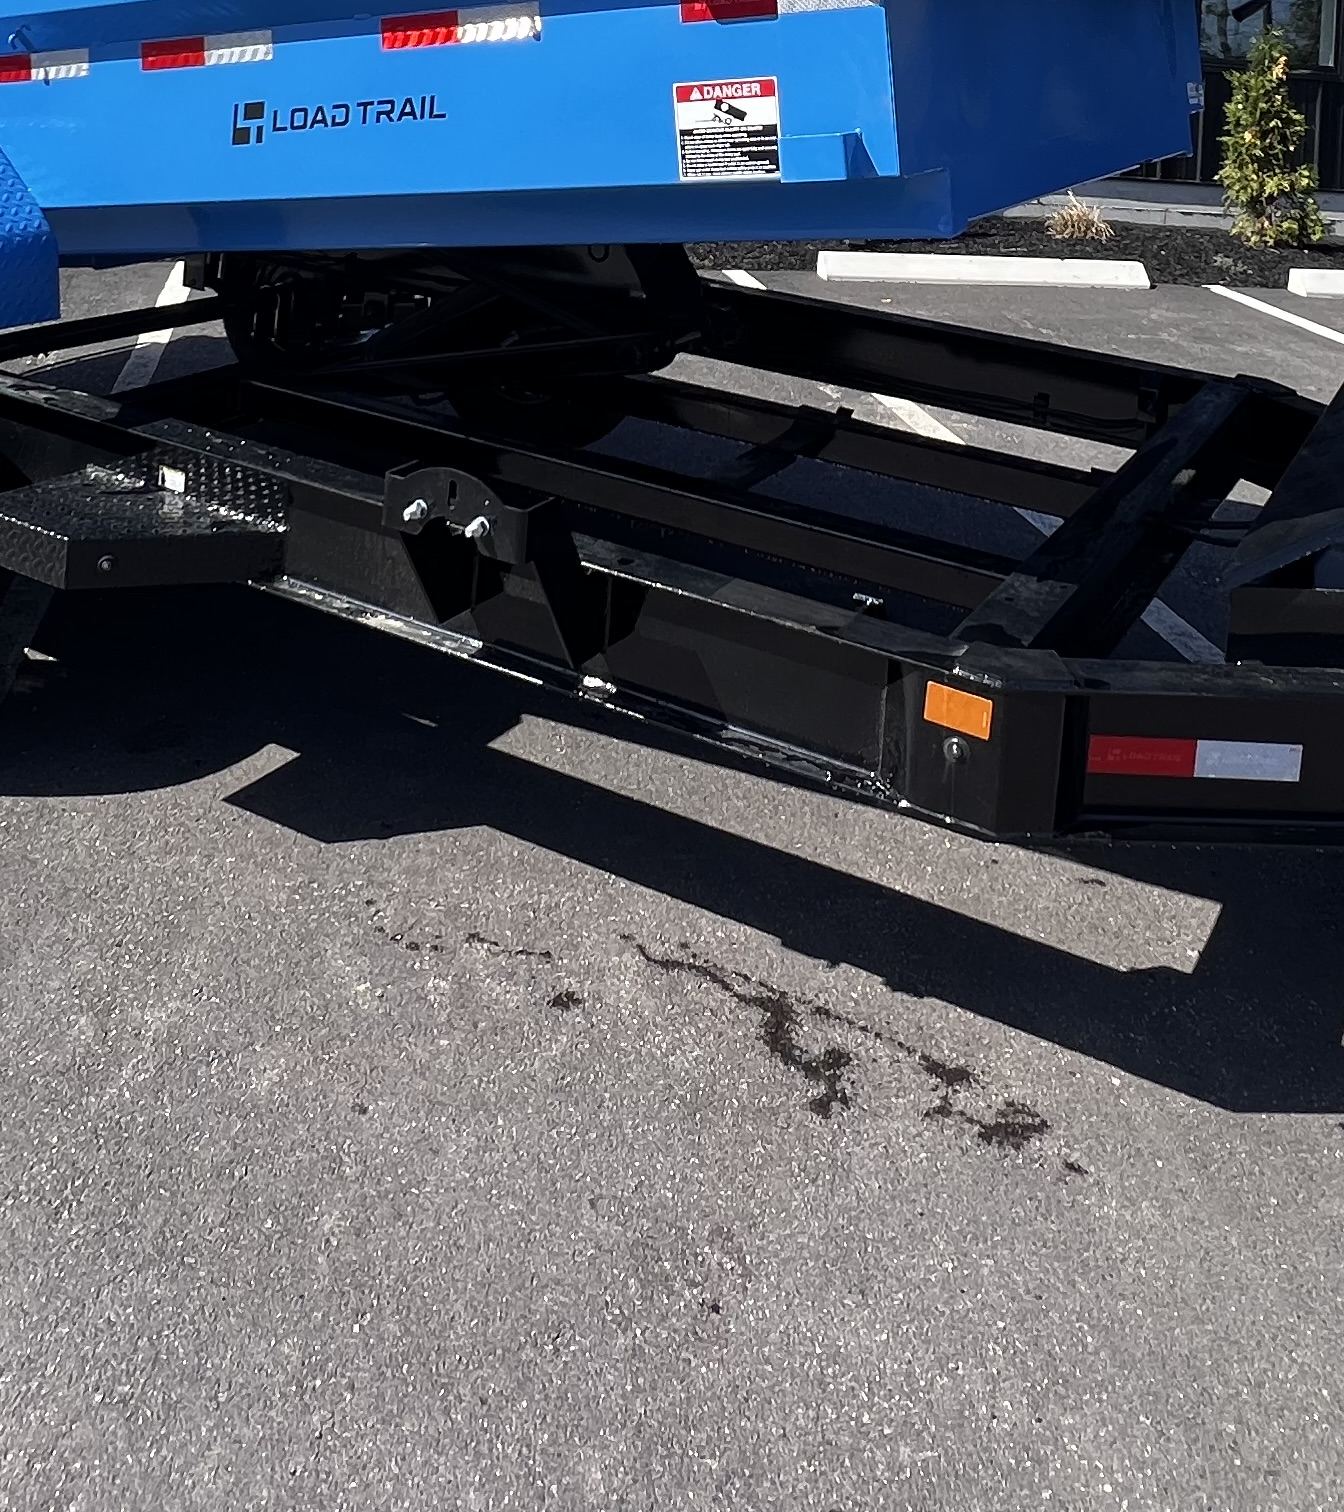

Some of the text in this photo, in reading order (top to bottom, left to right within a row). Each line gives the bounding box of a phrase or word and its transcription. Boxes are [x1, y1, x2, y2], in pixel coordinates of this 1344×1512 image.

[704, 82, 761, 100] DANGER
[272, 95, 447, 132] LOAD TRAIL
